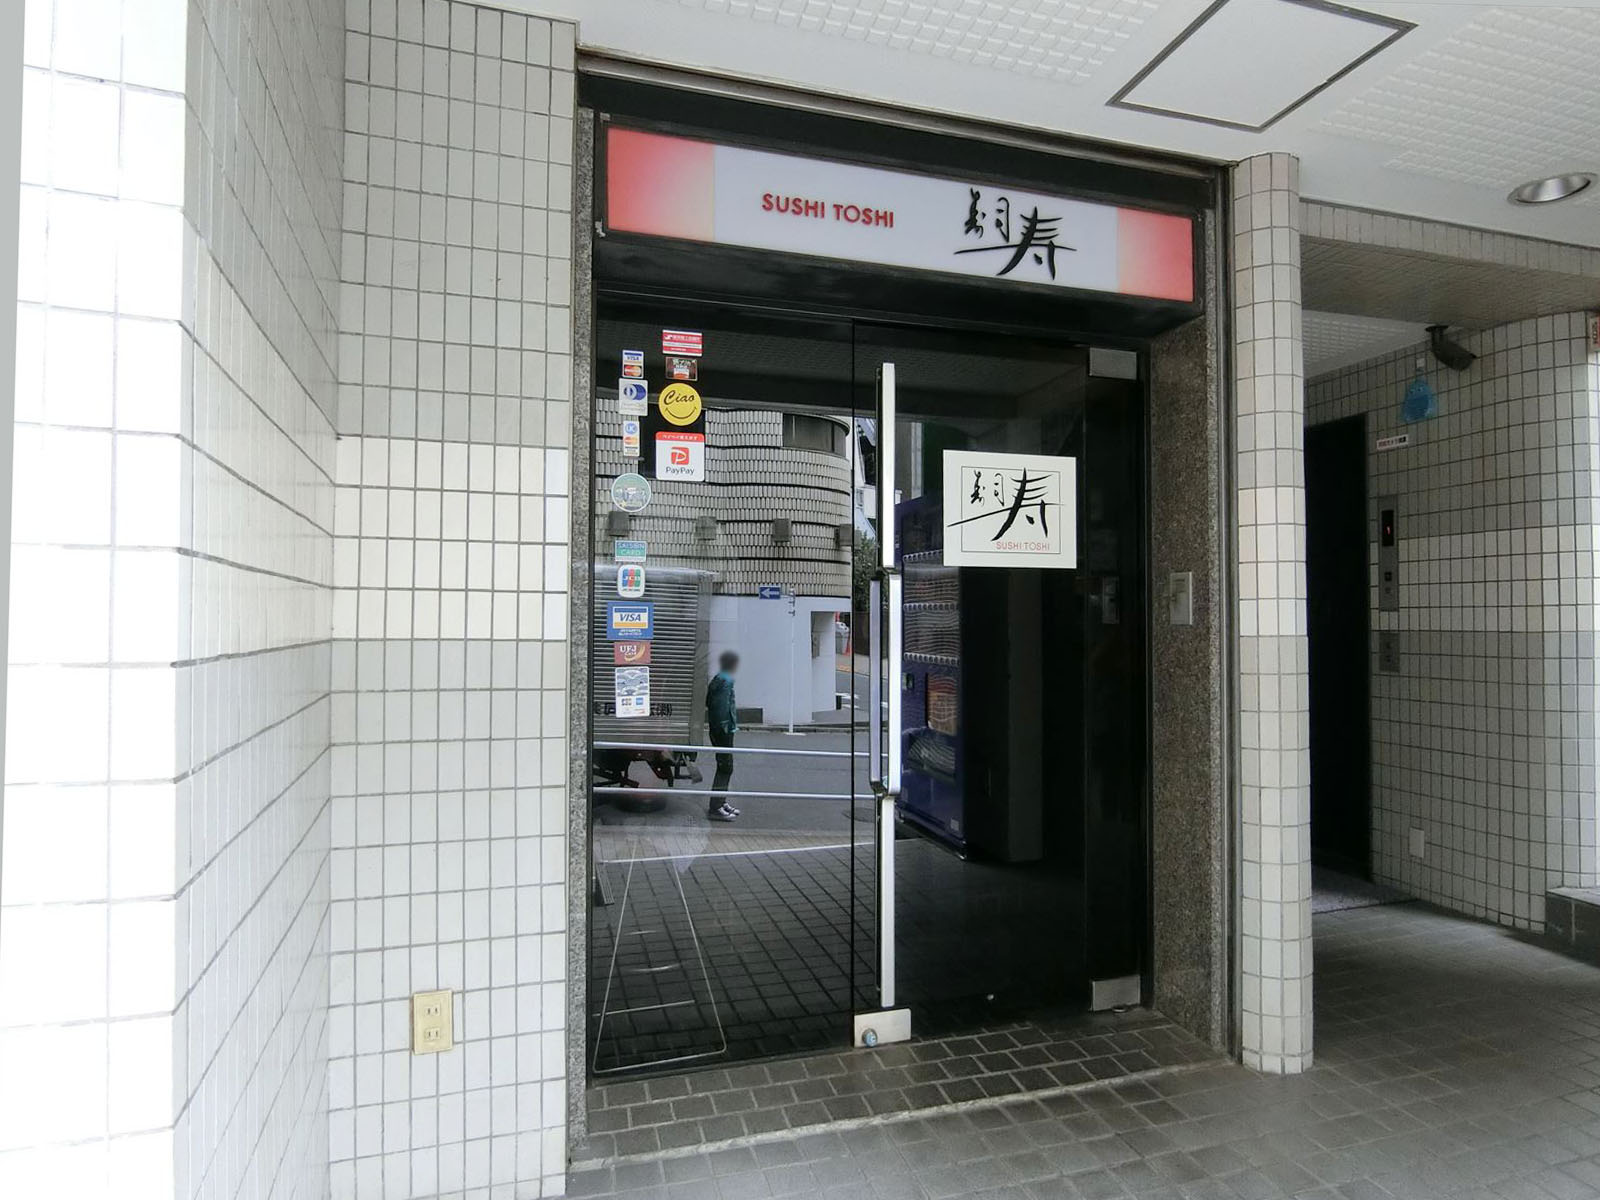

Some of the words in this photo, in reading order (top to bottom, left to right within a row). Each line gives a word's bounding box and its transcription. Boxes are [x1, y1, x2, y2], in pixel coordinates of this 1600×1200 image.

[762, 193, 825, 218] SUSHI
[833, 203, 894, 228] TOSHI
[664, 389, 695, 405] Ciao
[665, 466, 695, 475] PayPay
[996, 541, 1021, 550] SUSHI
[1024, 542, 1050, 551] TOSHI
[619, 613, 641, 622] VISA
[620, 645, 637, 653] UFJ
